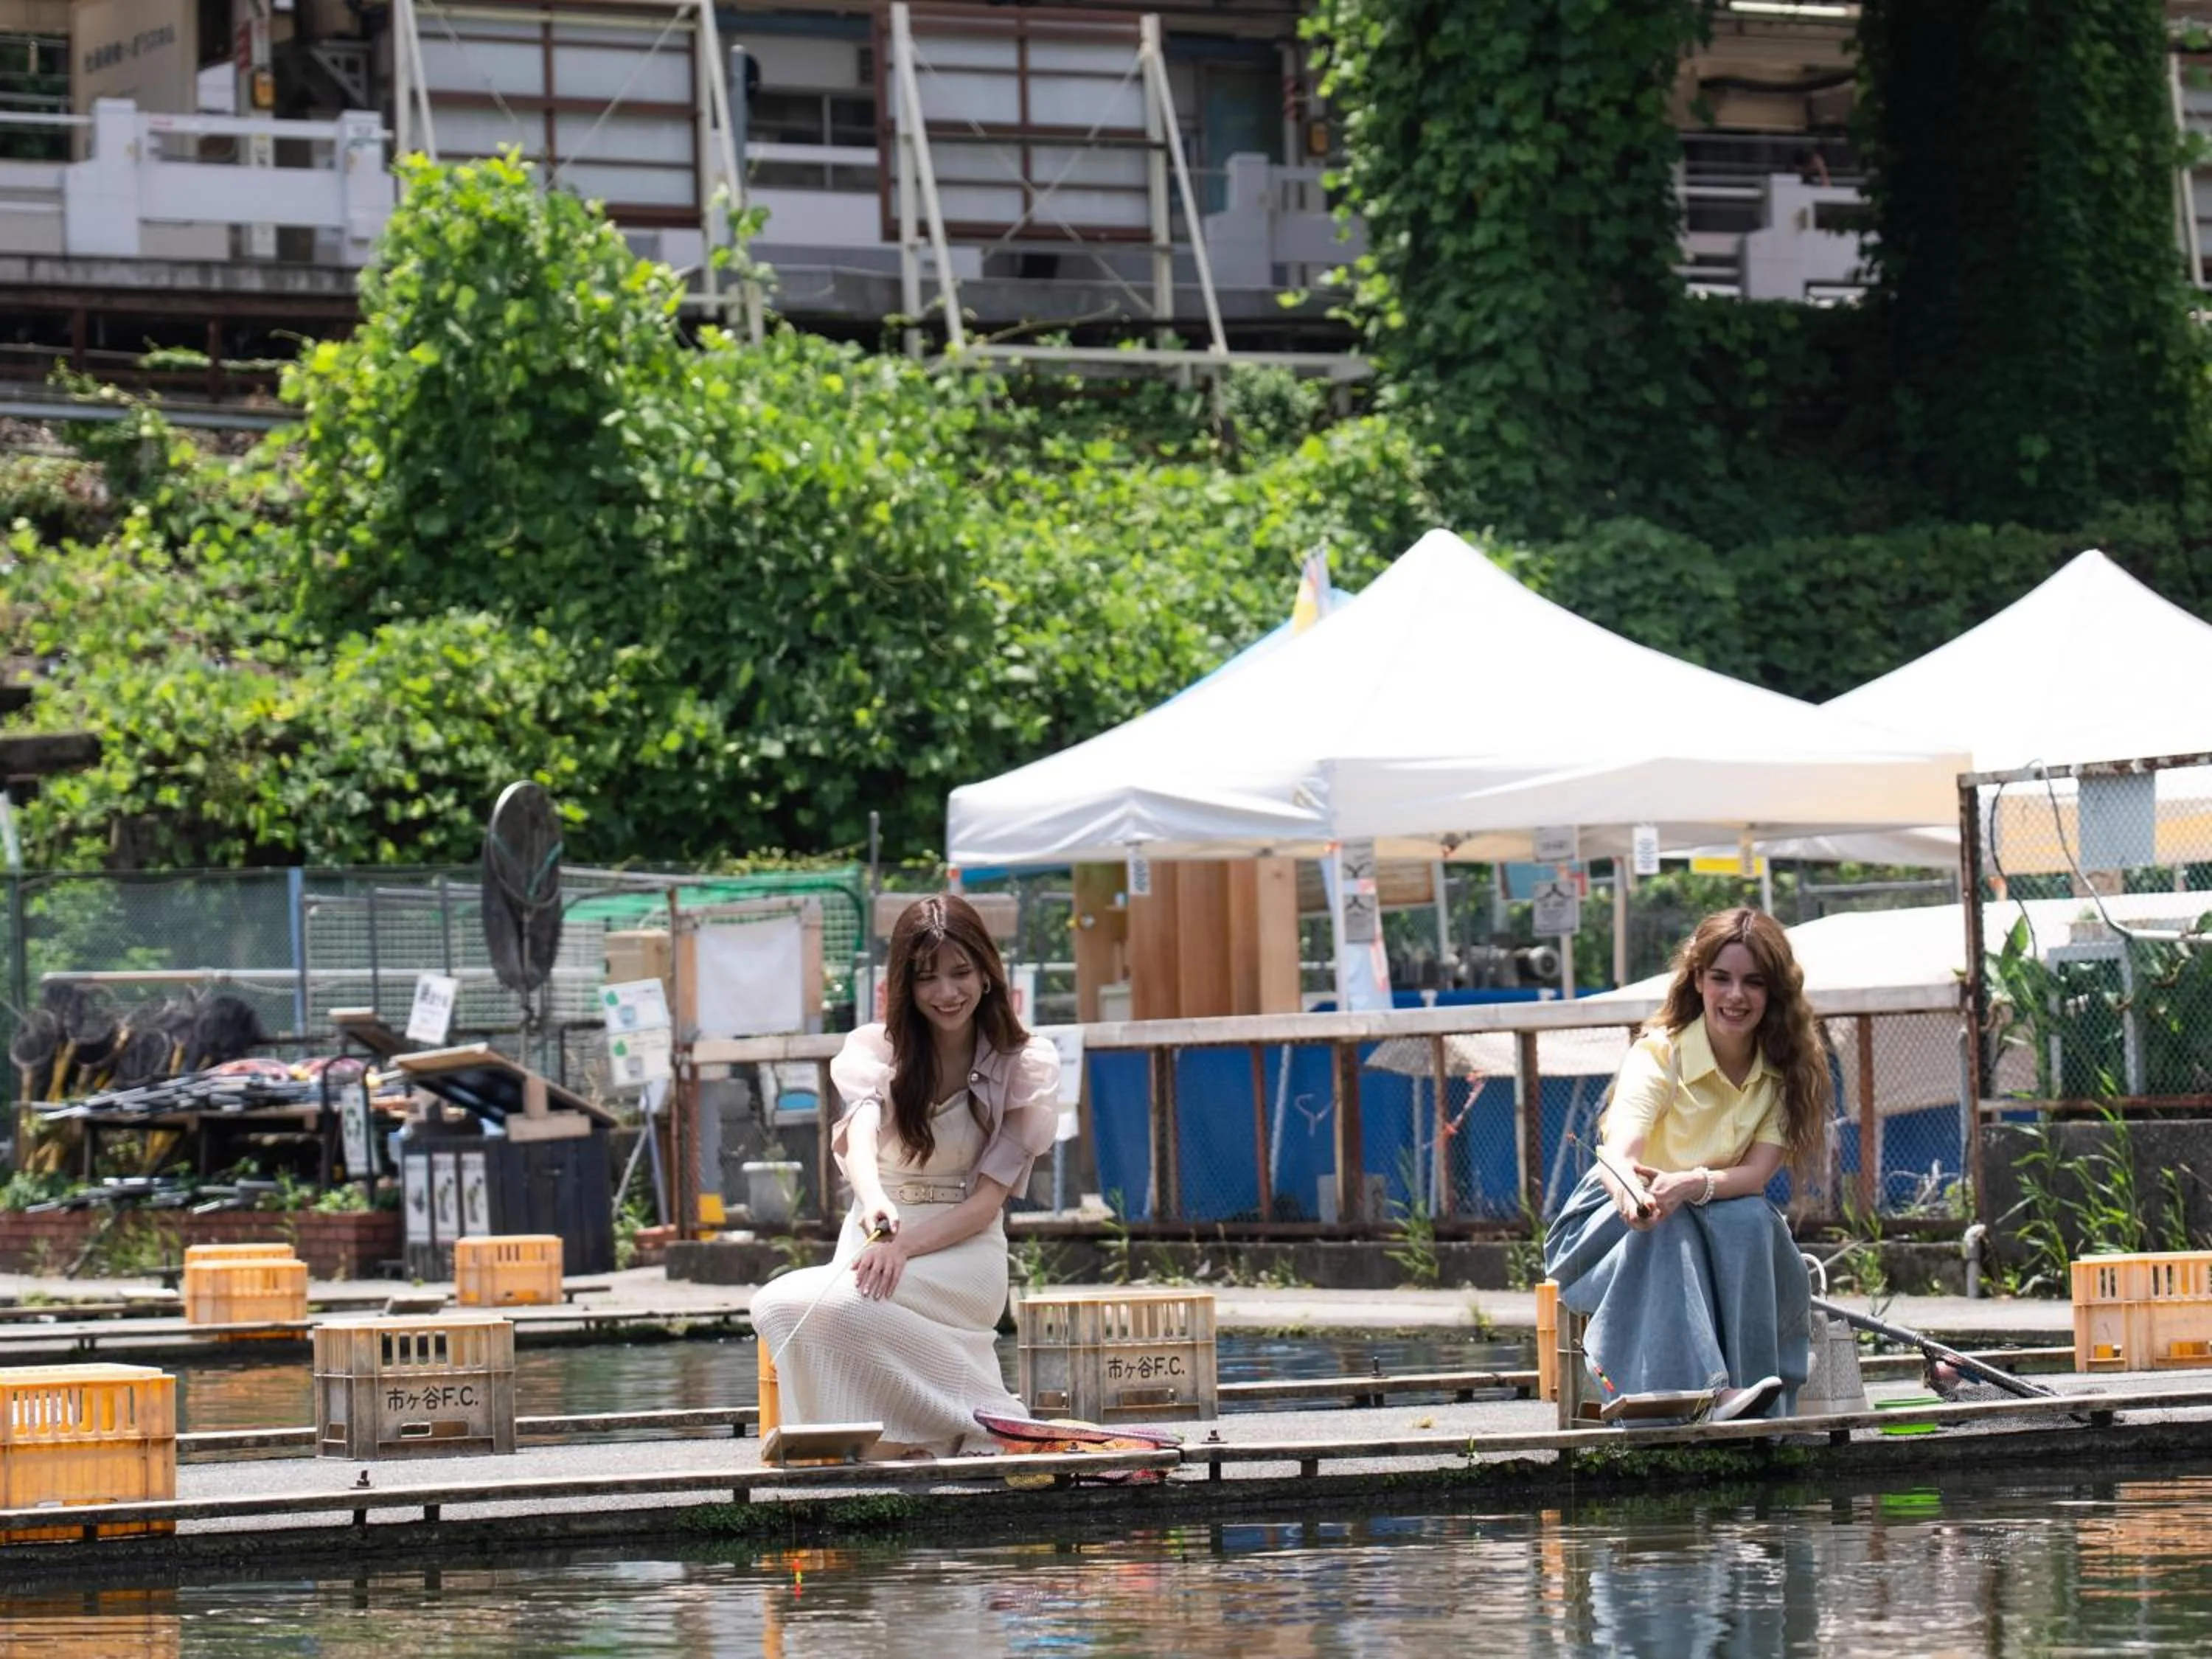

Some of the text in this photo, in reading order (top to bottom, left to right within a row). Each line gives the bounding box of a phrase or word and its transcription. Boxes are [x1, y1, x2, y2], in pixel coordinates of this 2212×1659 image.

[1107, 1356, 1186, 1380] 市ヶ谷F.C.
[386, 1386, 479, 1411] 市ヶ谷F.C.
